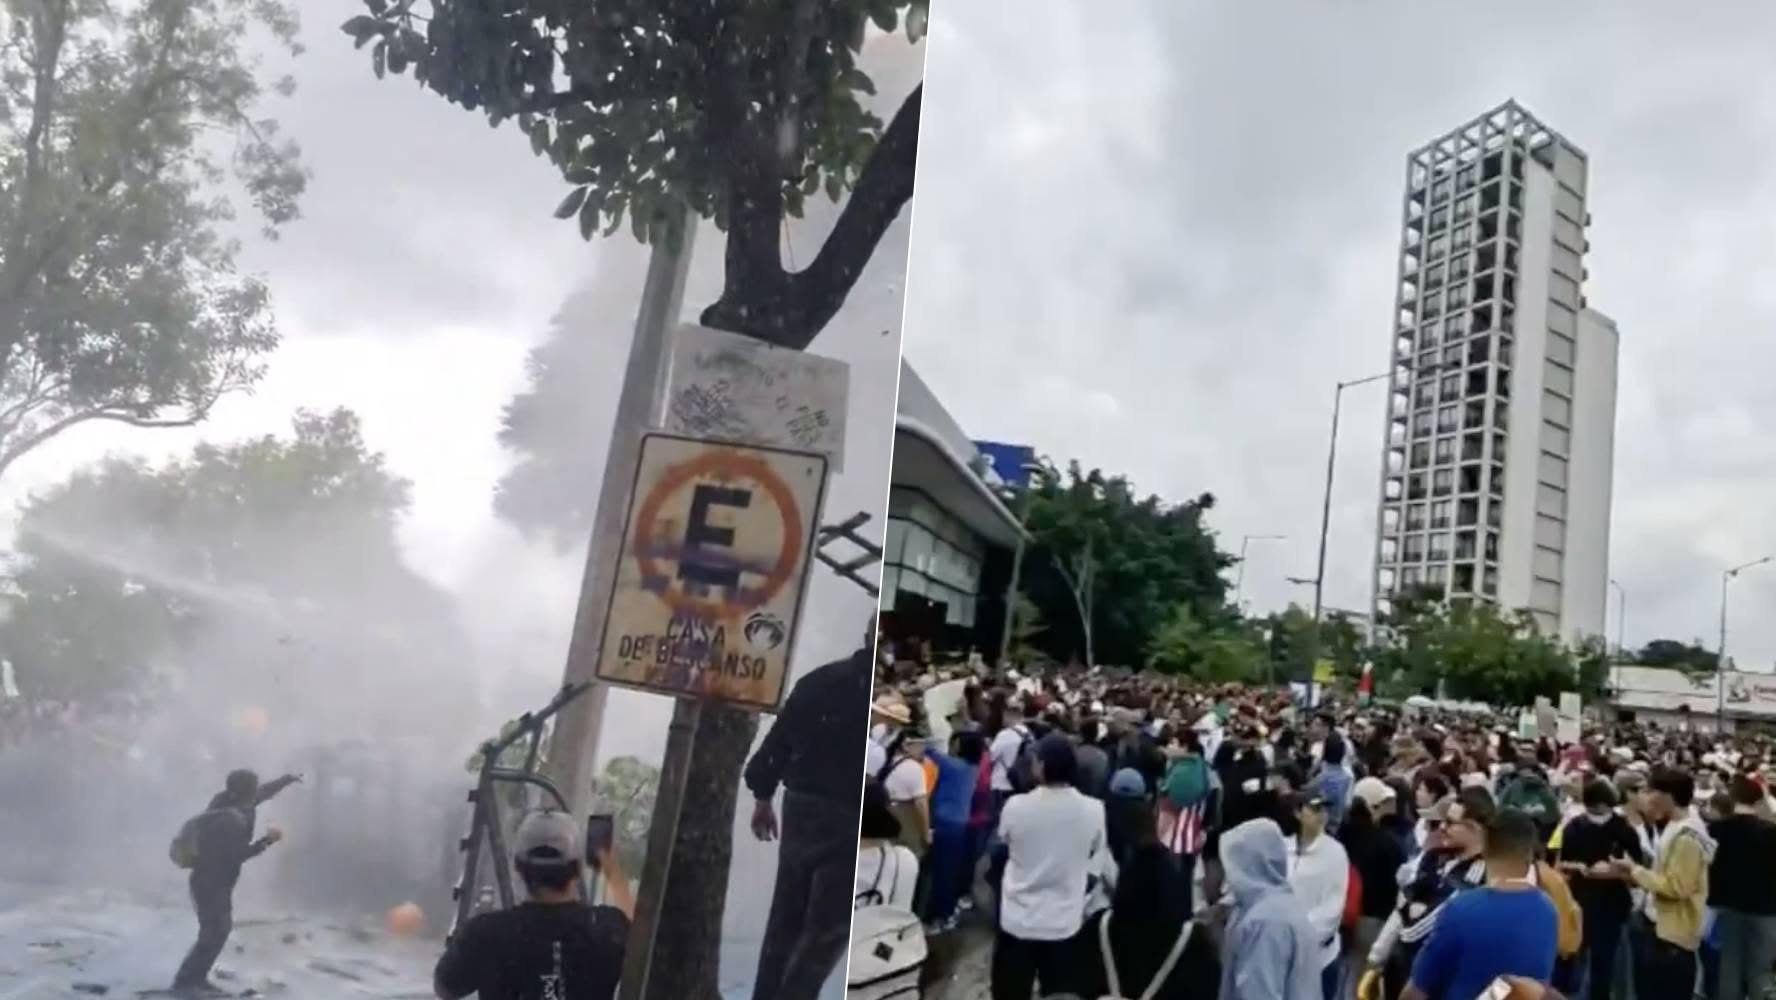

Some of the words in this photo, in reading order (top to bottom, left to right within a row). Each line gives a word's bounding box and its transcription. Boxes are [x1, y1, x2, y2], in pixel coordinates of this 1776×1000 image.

[677, 485, 752, 586] E
[618, 634, 645, 661] DE
[665, 616, 725, 650] CASA
